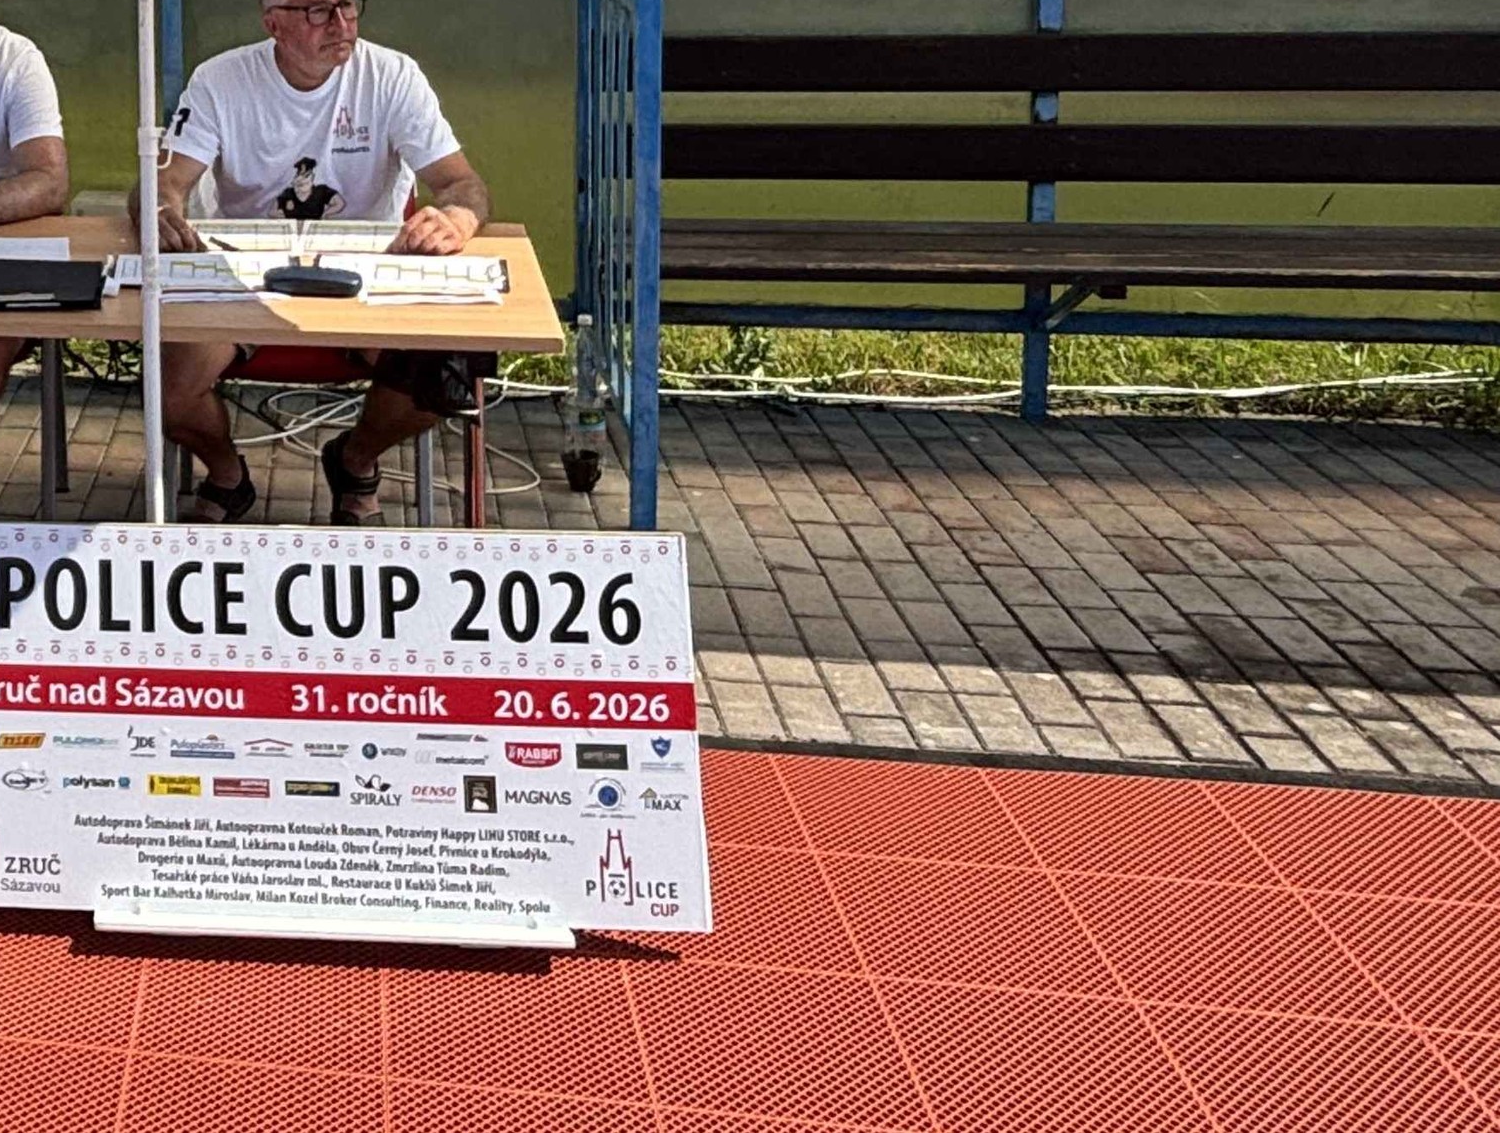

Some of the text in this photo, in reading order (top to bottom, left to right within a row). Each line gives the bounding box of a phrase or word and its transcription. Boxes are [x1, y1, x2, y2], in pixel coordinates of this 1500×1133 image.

[275, 562, 421, 639] CUP
[450, 569, 642, 645] 2026
[49, 677, 106, 705] nad
[115, 678, 245, 710] Sázavou
[291, 684, 448, 717] 31. ročník
[494, 690, 670, 722] 20. 6. 2026
[517, 747, 559, 761] RABBIT
[63, 775, 115, 789] polysan
[412, 785, 457, 797] DENSO
[350, 792, 402, 807] SPIRALY
[505, 789, 572, 806] MAGNAS
[74, 814, 143, 830] Autodoprava
[216, 819, 286, 835] Autoopravna
[288, 822, 338, 836] Kotouček
[386, 825, 439, 842] Potraviny
[441, 827, 476, 843] Happy
[508, 830, 541, 843] STORE
[97, 832, 166, 848] Autodoprava
[242, 838, 286, 852] Lékárna
[288, 842, 295, 852] u
[298, 840, 339, 855] Anděla,
[342, 842, 371, 855] Obuv
[372, 840, 403, 858] Černý
[405, 843, 437, 858] Josef,
[439, 845, 479, 859] Pivnice
[481, 849, 489, 859] u
[491, 846, 552, 863] Krokodýla,
[4, 854, 61, 876] ZRUČ
[138, 851, 184, 866] Drogerie
[186, 856, 194, 865] u
[232, 854, 301, 871] Autoopravna
[304, 857, 338, 871] Louda
[386, 860, 435, 874] Zmrzlina
[437, 862, 468, 876] Tůma
[0, 877, 61, 894] Sázavou
[152, 868, 198, 883] Tesařské
[200, 870, 229, 885] práce
[261, 873, 305, 887] Jaroslav
[331, 876, 392, 891] Restaurace
[394, 878, 402, 890] U
[439, 878, 473, 893] Šimek
[101, 884, 130, 899] Sport
[133, 885, 151, 898] Bar
[205, 888, 253, 903] Miroslav,
[256, 890, 287, 903] Milan
[289, 891, 318, 904] Kozel
[321, 892, 357, 906] Broker
[359, 894, 422, 911] Consulting,
[519, 900, 551, 915] Spolu
[650, 903, 679, 917] CUP
